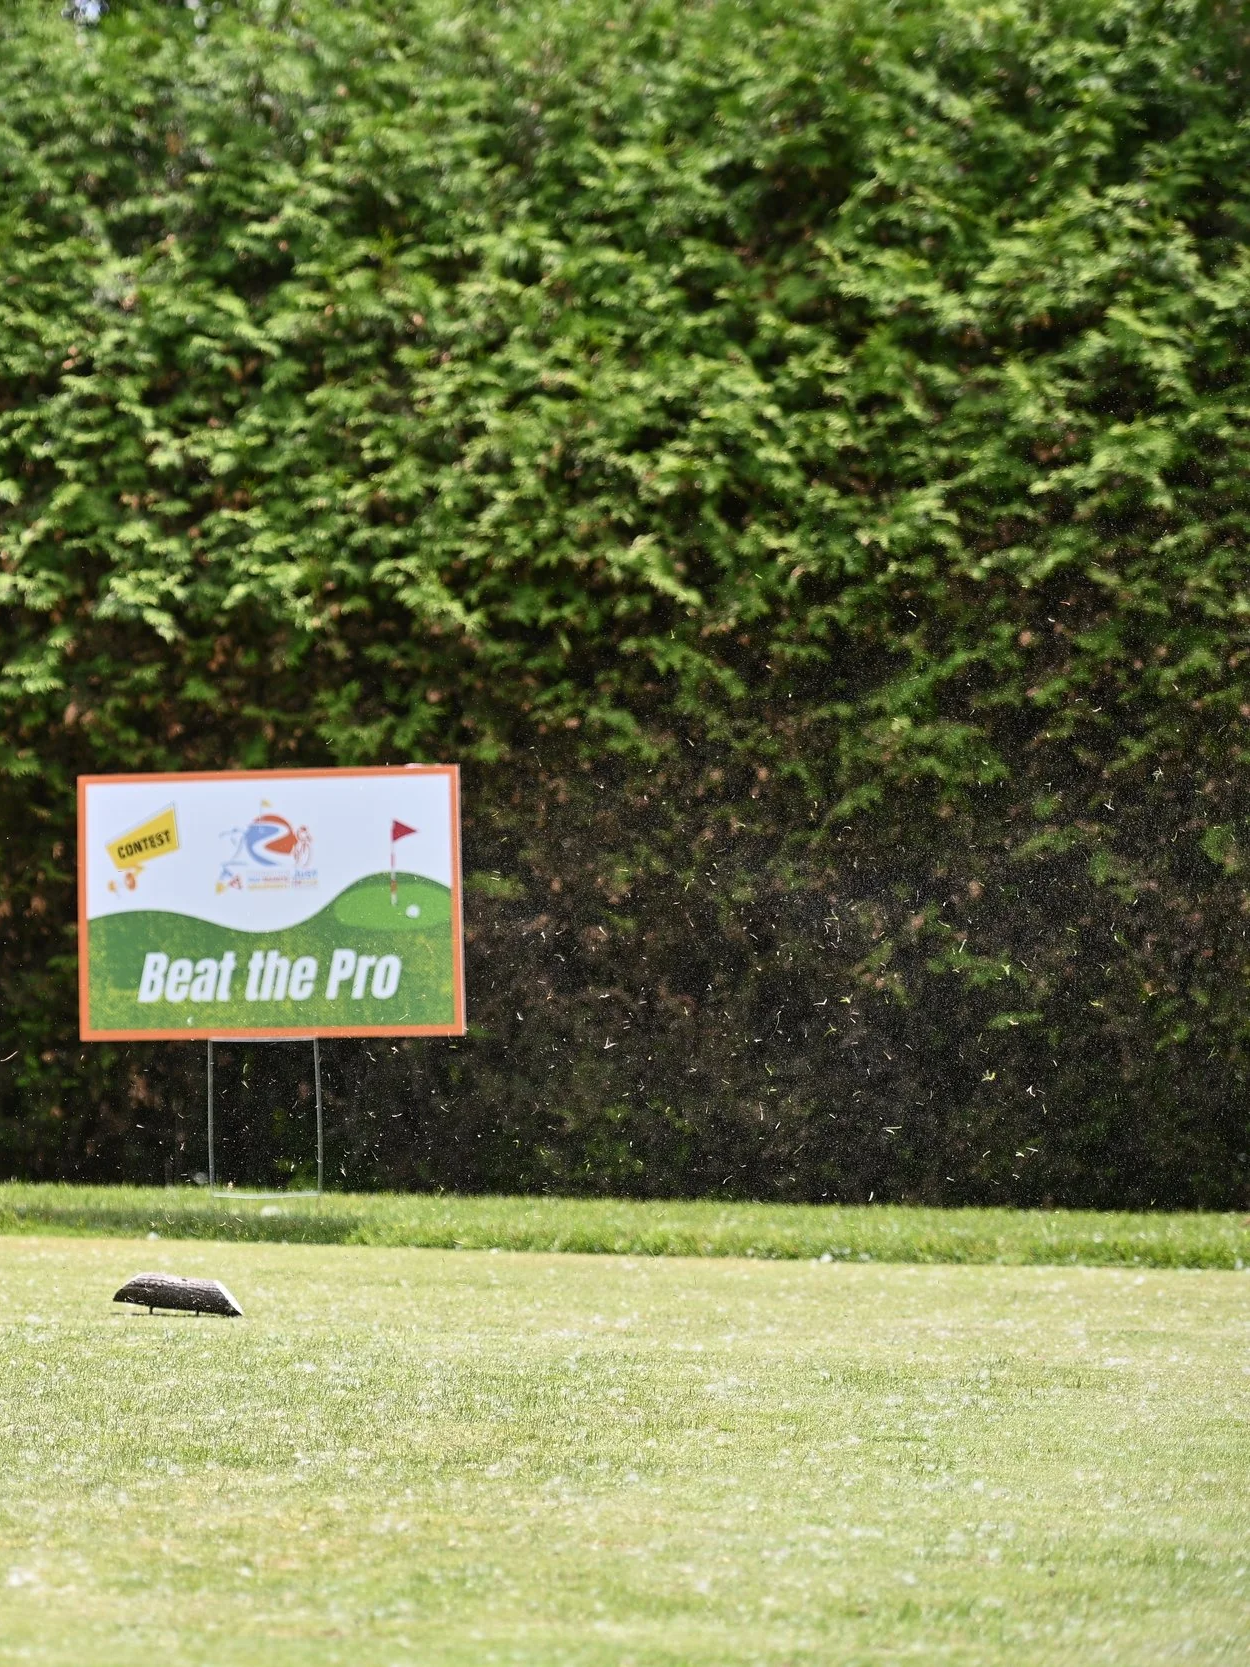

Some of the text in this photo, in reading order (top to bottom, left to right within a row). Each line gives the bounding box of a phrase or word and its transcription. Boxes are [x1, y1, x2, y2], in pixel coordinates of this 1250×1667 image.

[117, 829, 171, 859] CONTEST
[137, 948, 401, 1002] Beat the Pro
